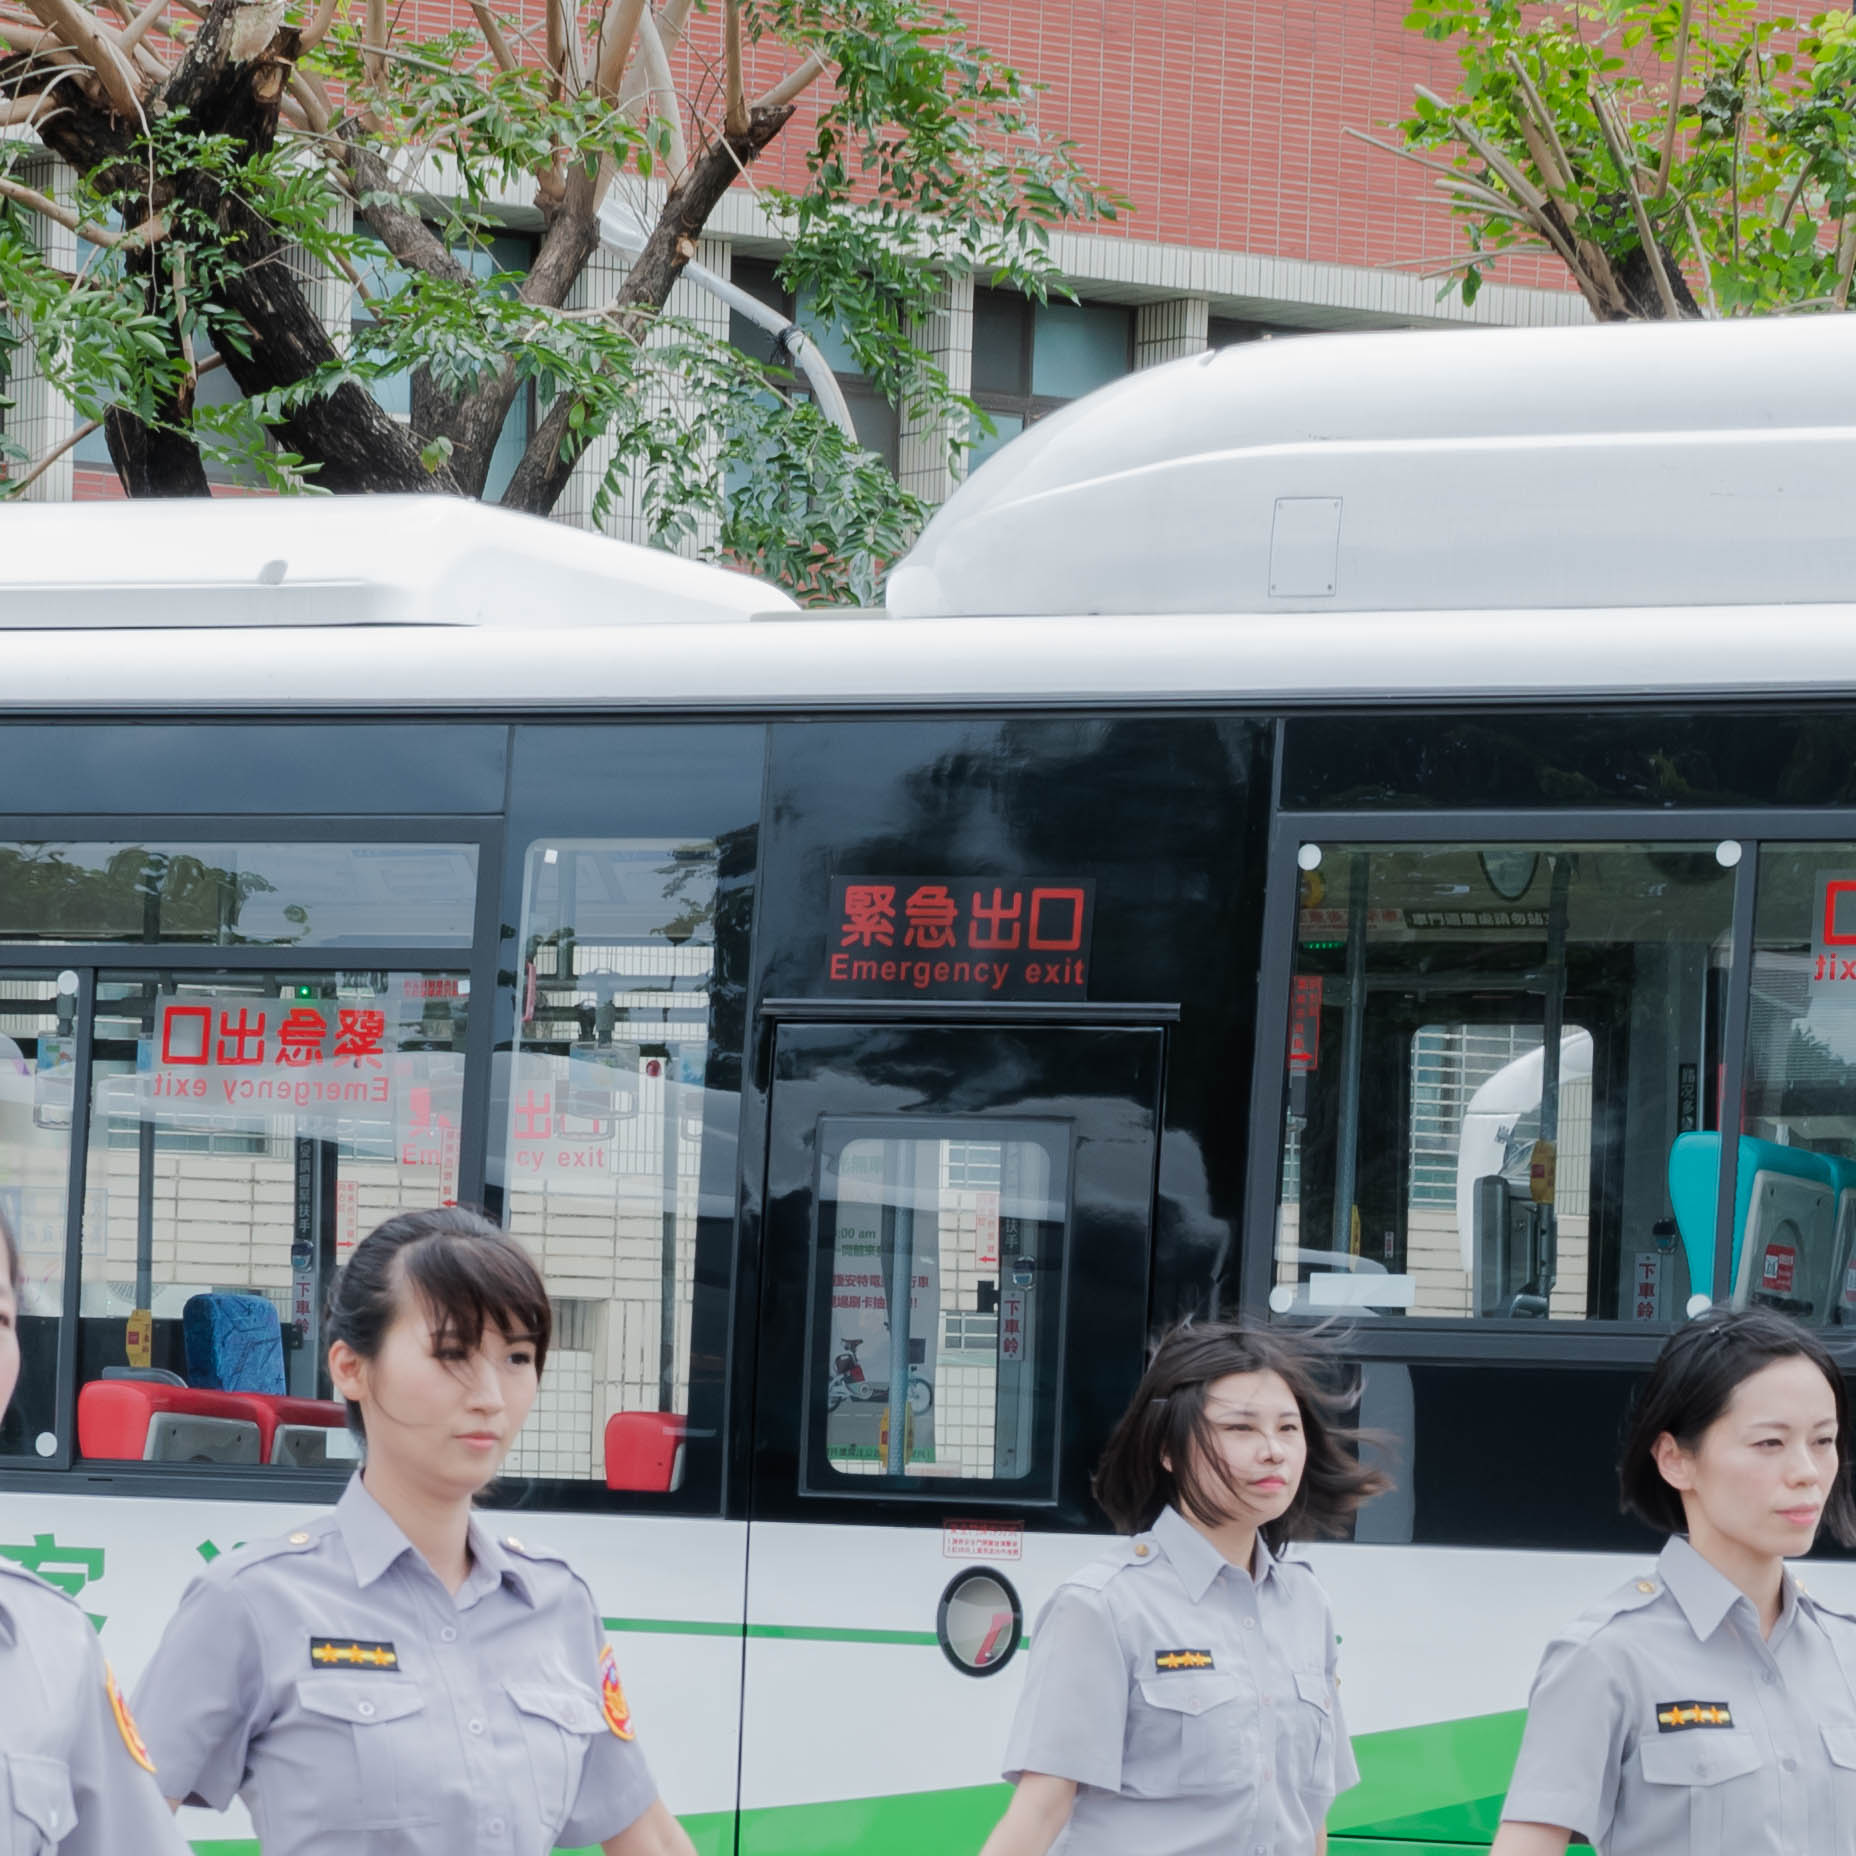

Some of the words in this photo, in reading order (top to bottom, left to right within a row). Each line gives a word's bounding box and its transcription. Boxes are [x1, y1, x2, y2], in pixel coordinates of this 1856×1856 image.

[840, 884, 1085, 951] 緊急出口
[829, 953, 1010, 990] Emergency
[1024, 958, 1085, 984] exit
[557, 1144, 604, 1168] exit
[1636, 1262, 1657, 1319] 下車鈴
[1003, 1300, 1021, 1354] 下車鈴
